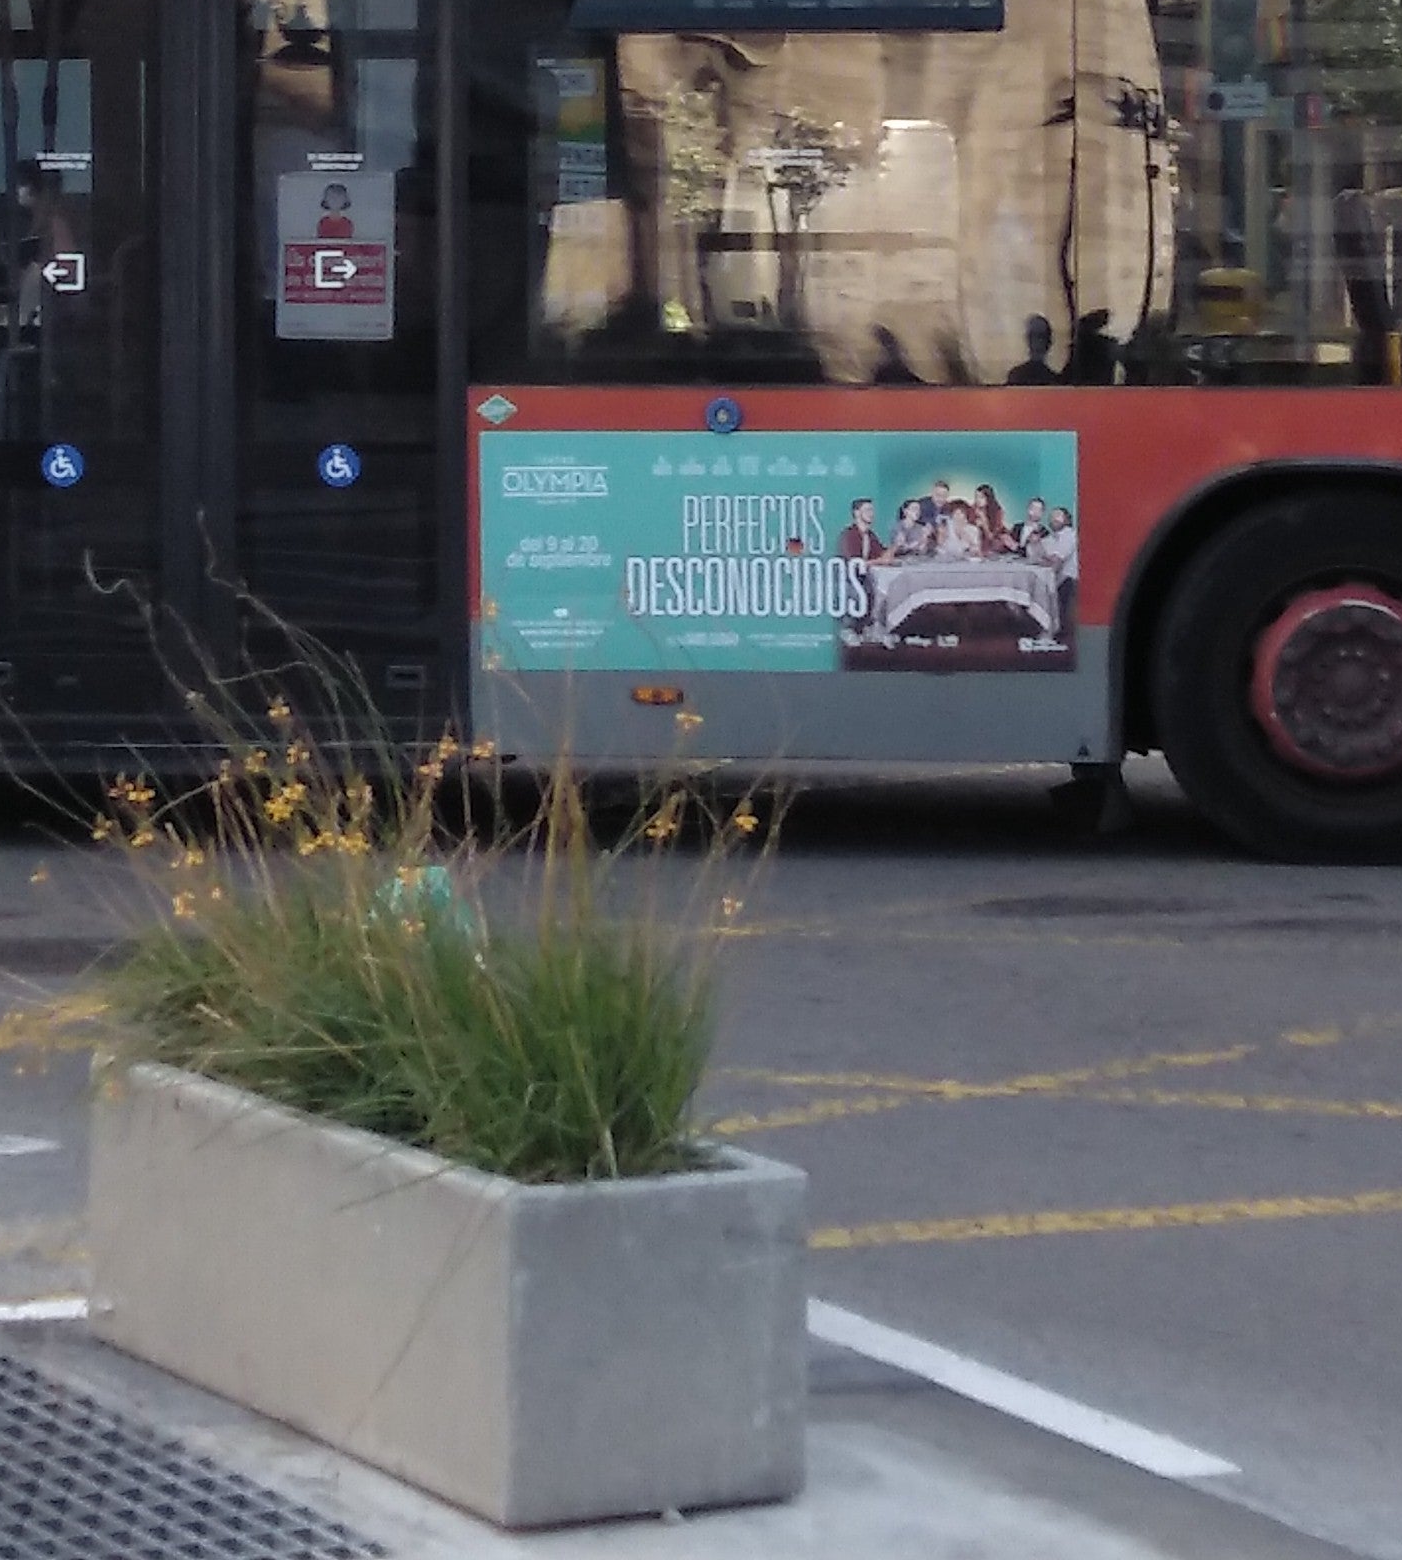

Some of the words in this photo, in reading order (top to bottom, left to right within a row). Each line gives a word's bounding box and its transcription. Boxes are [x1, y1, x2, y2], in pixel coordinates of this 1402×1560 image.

[502, 471, 609, 492] OLYMPIA
[683, 494, 825, 556] PERFECTOS
[626, 555, 869, 618] DESCONOCIDOS
